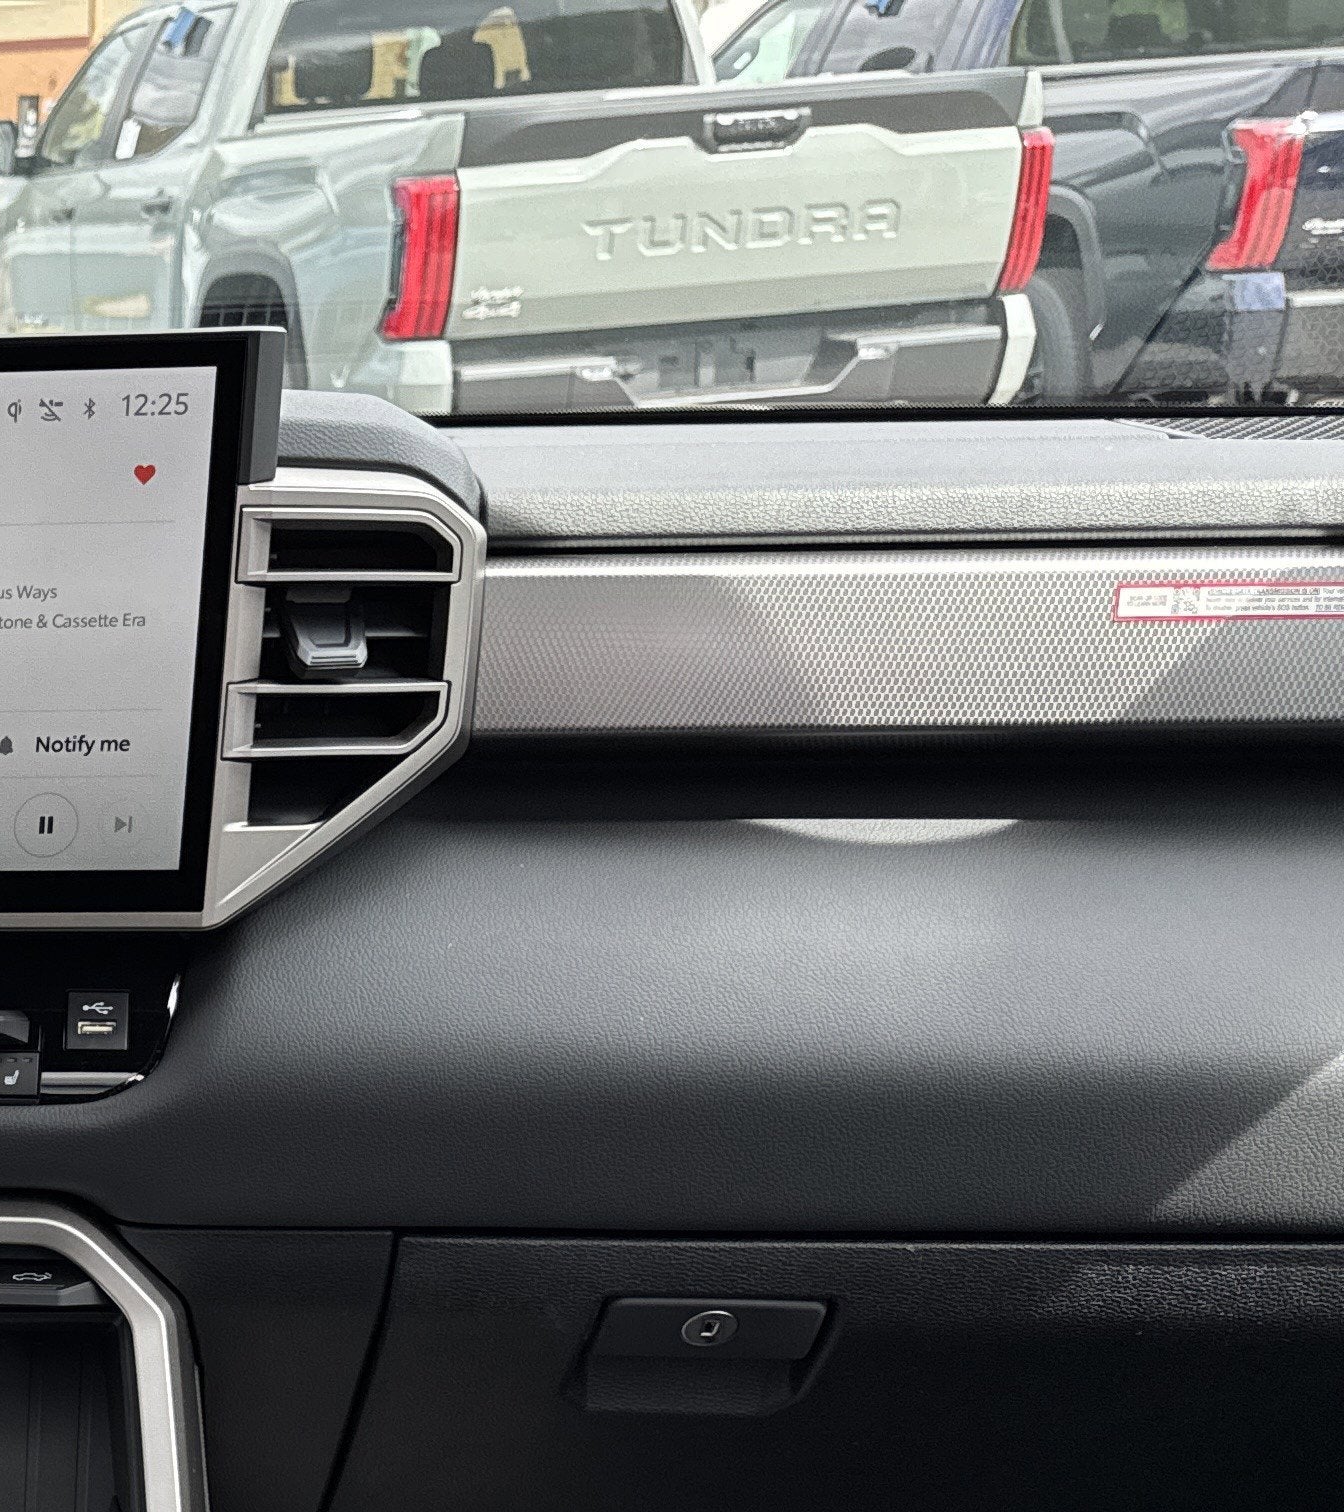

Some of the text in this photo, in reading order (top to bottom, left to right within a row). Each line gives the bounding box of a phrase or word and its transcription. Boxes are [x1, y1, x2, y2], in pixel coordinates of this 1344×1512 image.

[580, 198, 901, 262] TUNDRA
[121, 392, 190, 417] 12:25
[17, 584, 58, 603] Ways
[36, 614, 48, 629] &
[52, 613, 119, 629] Cassette
[123, 612, 147, 628] Era
[35, 735, 131, 757] Notify me
